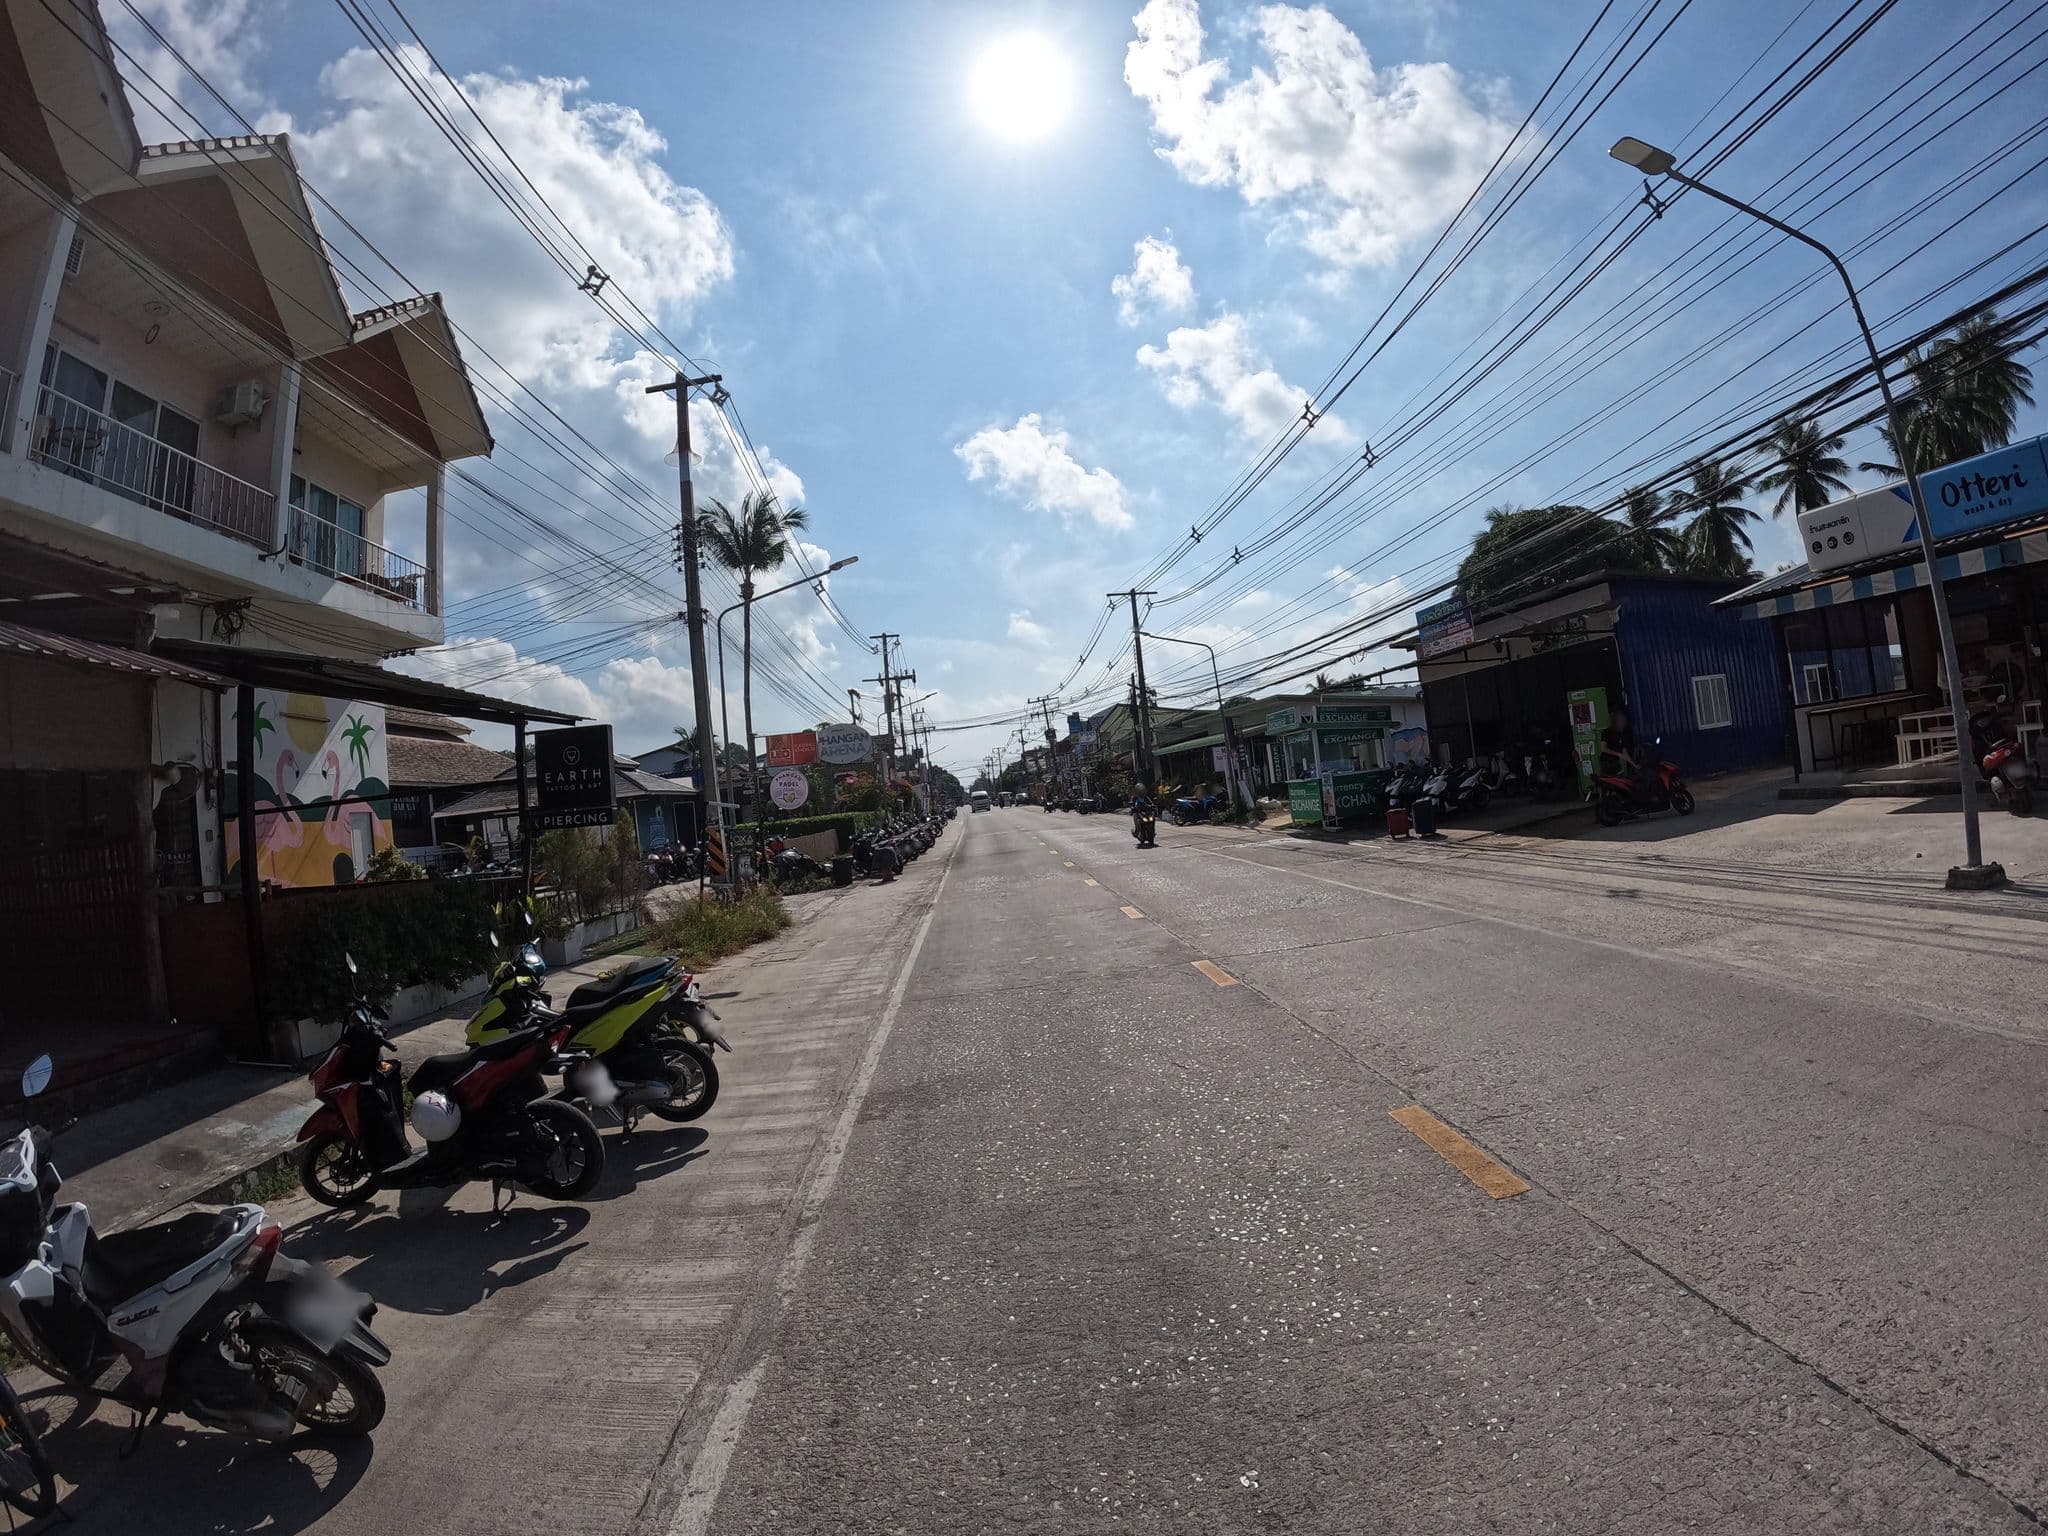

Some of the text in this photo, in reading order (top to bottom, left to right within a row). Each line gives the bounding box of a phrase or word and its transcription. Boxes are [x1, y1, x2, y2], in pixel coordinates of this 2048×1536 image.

[1941, 463, 2029, 507] Otteri
[1963, 497, 2012, 516] wash & dry
[1320, 713, 1369, 722] EXCHANGE
[1324, 731, 1378, 744] EXCHANGE
[545, 768, 601, 783] EARTH
[546, 784, 576, 792] TATTOO
[1335, 782, 1365, 793] rrency
[1291, 799, 1321, 811] EXCHANGE
[544, 812, 608, 827] PIERCING
